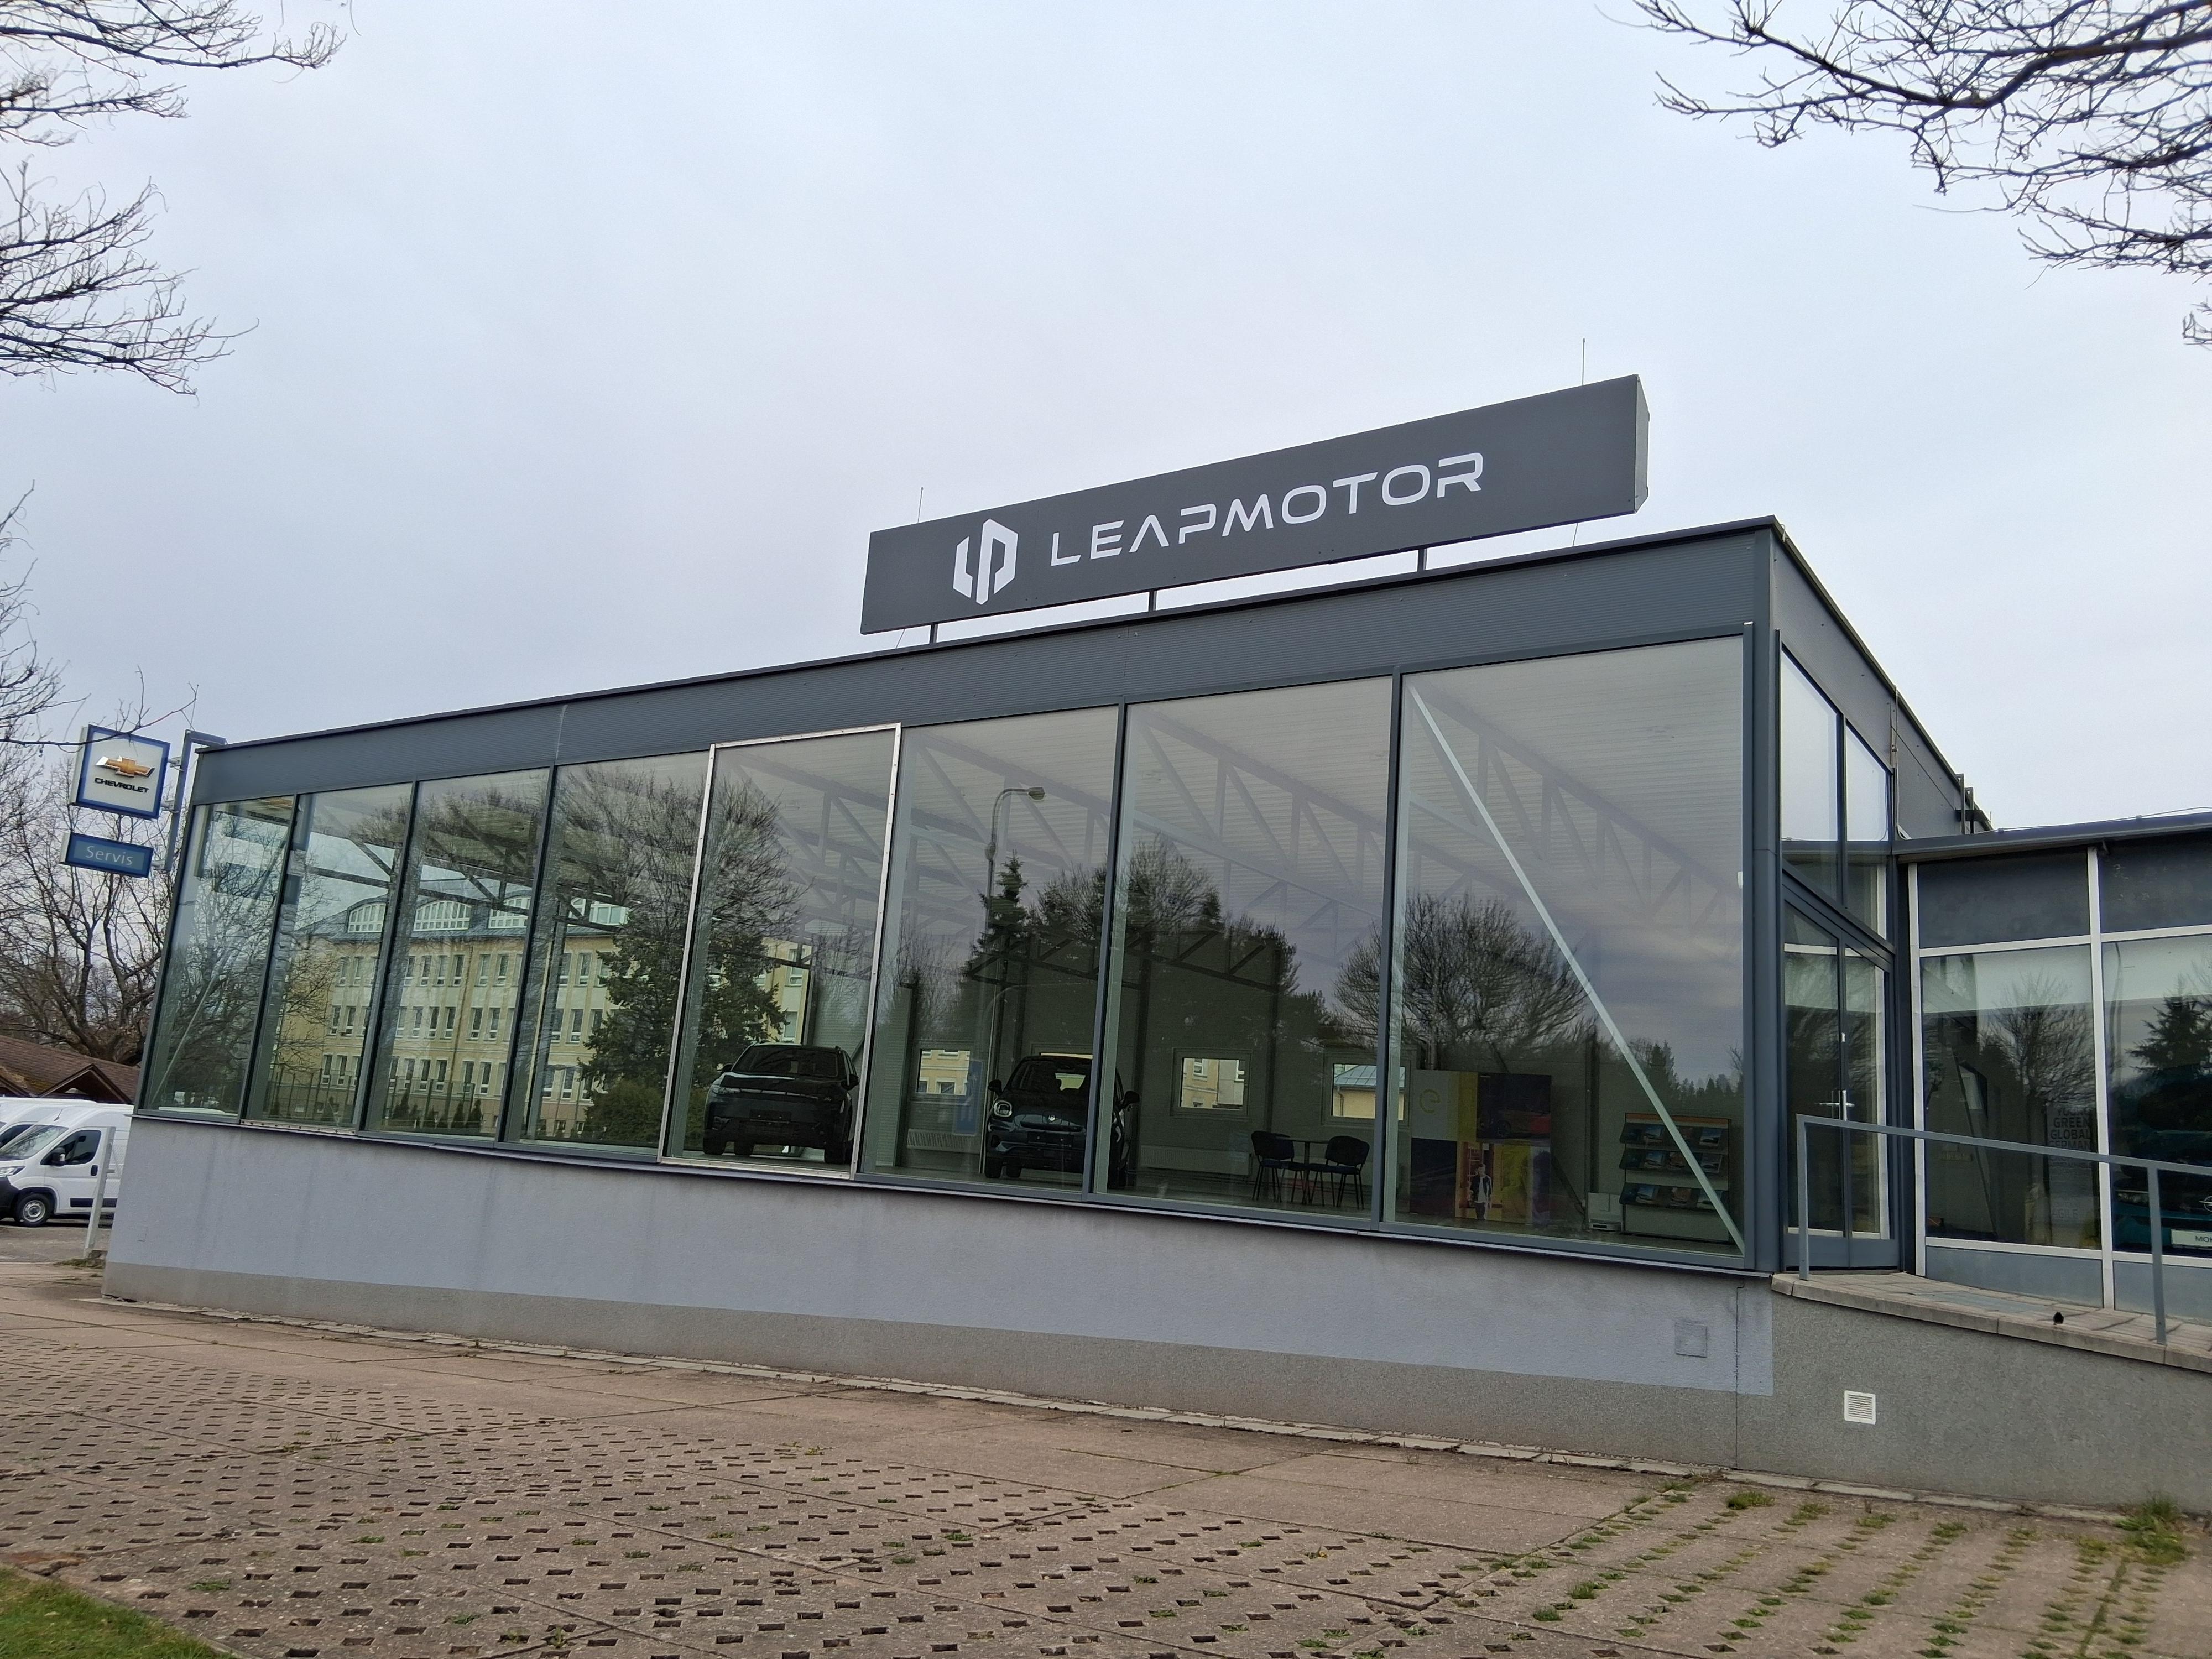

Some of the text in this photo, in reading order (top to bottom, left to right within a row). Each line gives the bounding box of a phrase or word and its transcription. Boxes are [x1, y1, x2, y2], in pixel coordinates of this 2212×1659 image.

[1051, 452, 1483, 567] LEAPMOTOR
[94, 778, 149, 793] CHEVROLET
[85, 846, 133, 865] Servis
[2053, 1117, 2089, 1128] GREEN
[2051, 1129, 2090, 1140] GLOBAL
